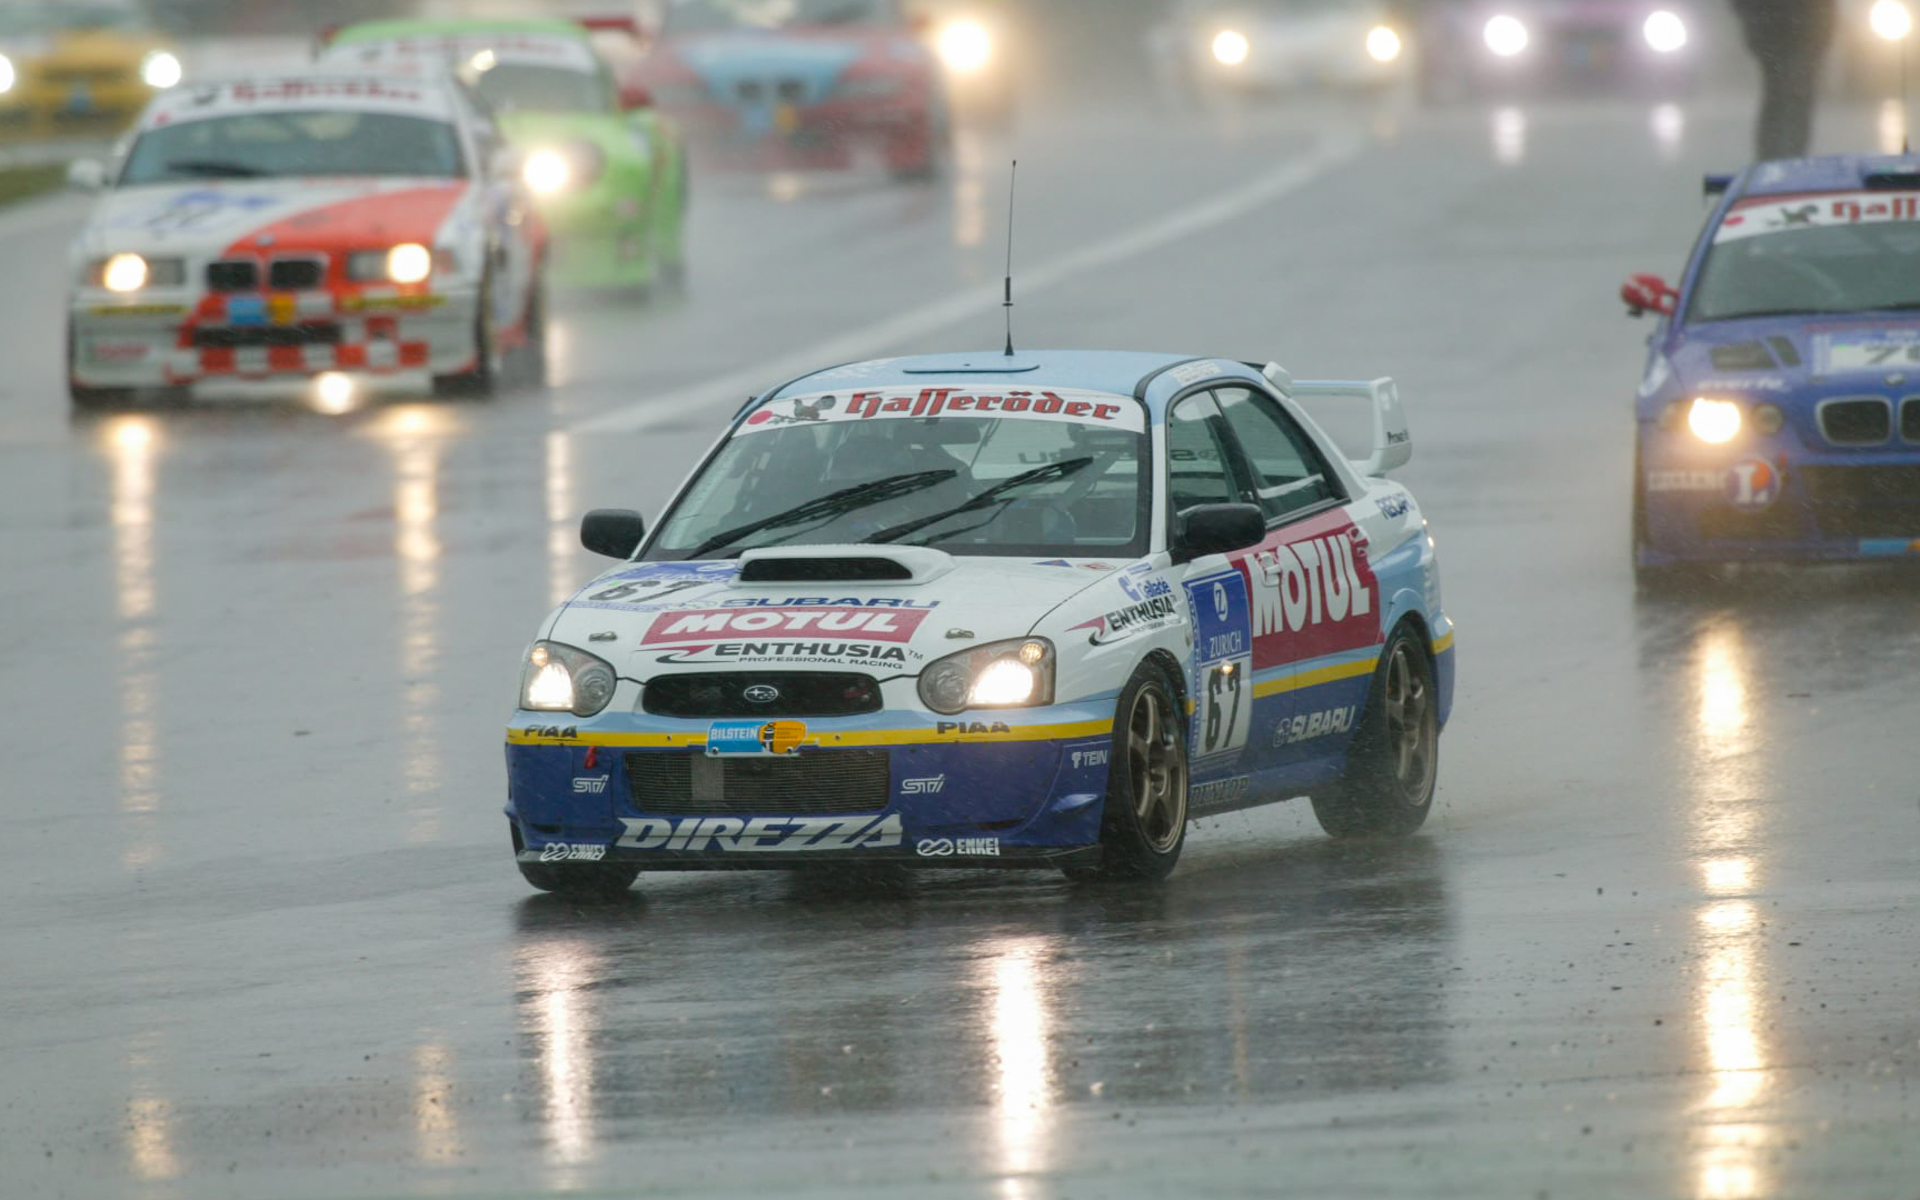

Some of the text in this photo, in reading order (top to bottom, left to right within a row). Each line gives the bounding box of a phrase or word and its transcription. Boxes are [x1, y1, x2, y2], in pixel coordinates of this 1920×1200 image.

[588, 580, 713, 603] 67
[1243, 533, 1370, 638] MOTUL
[719, 597, 941, 609] SUBARU
[1106, 596, 1176, 632] ENTHUSIA
[661, 610, 899, 635] MOTUL
[714, 642, 906, 662] ENTHUSIA
[1209, 630, 1242, 659] ZURICH
[738, 656, 904, 670] PROFESSIONAL RACING
[1205, 662, 1242, 752] 67
[710, 727, 758, 740] BILSTEIN
[936, 721, 1010, 734] PIAA
[1288, 704, 1356, 744] SUBARU
[1082, 750, 1108, 767] TEIN
[615, 814, 904, 852] DIREZZA
[956, 837, 1000, 857] ENKEI
